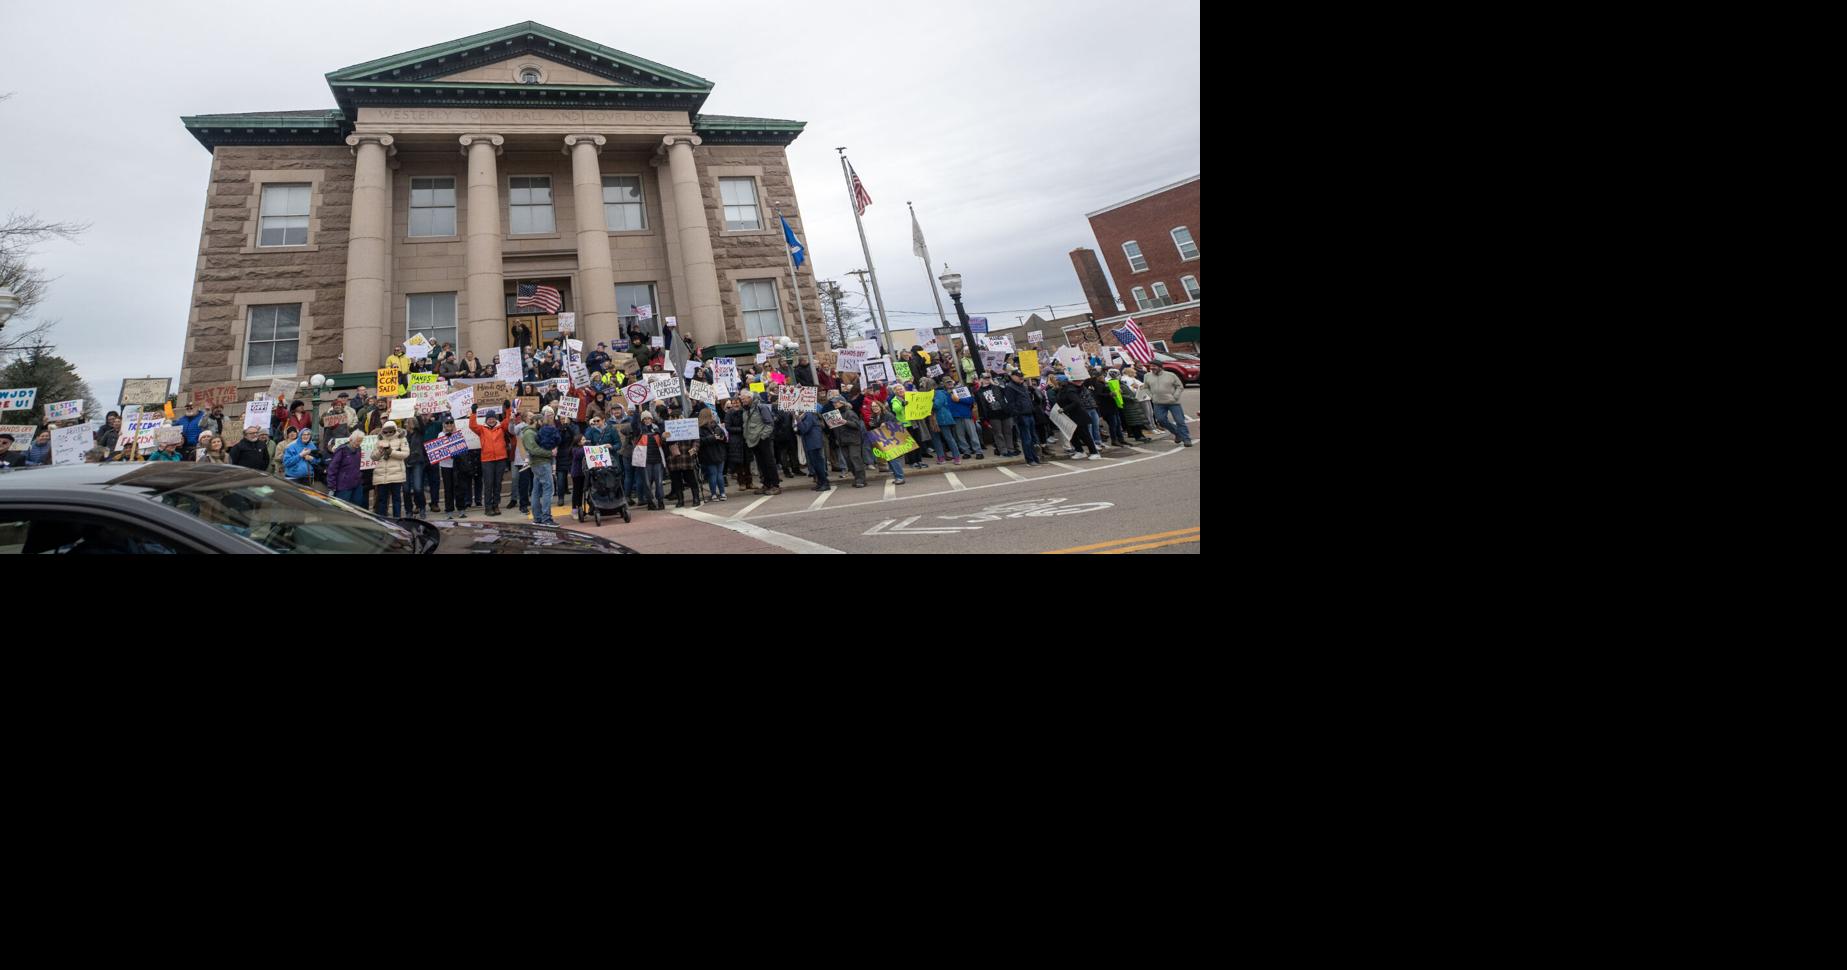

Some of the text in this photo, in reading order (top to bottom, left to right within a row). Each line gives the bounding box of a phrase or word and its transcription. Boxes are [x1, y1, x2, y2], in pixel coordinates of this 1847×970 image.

[379, 110, 450, 120] WESTERLY
[464, 111, 504, 120] TOWN
[512, 111, 544, 120] HALL
[552, 112, 579, 121] AND
[195, 387, 214, 401] EAT
